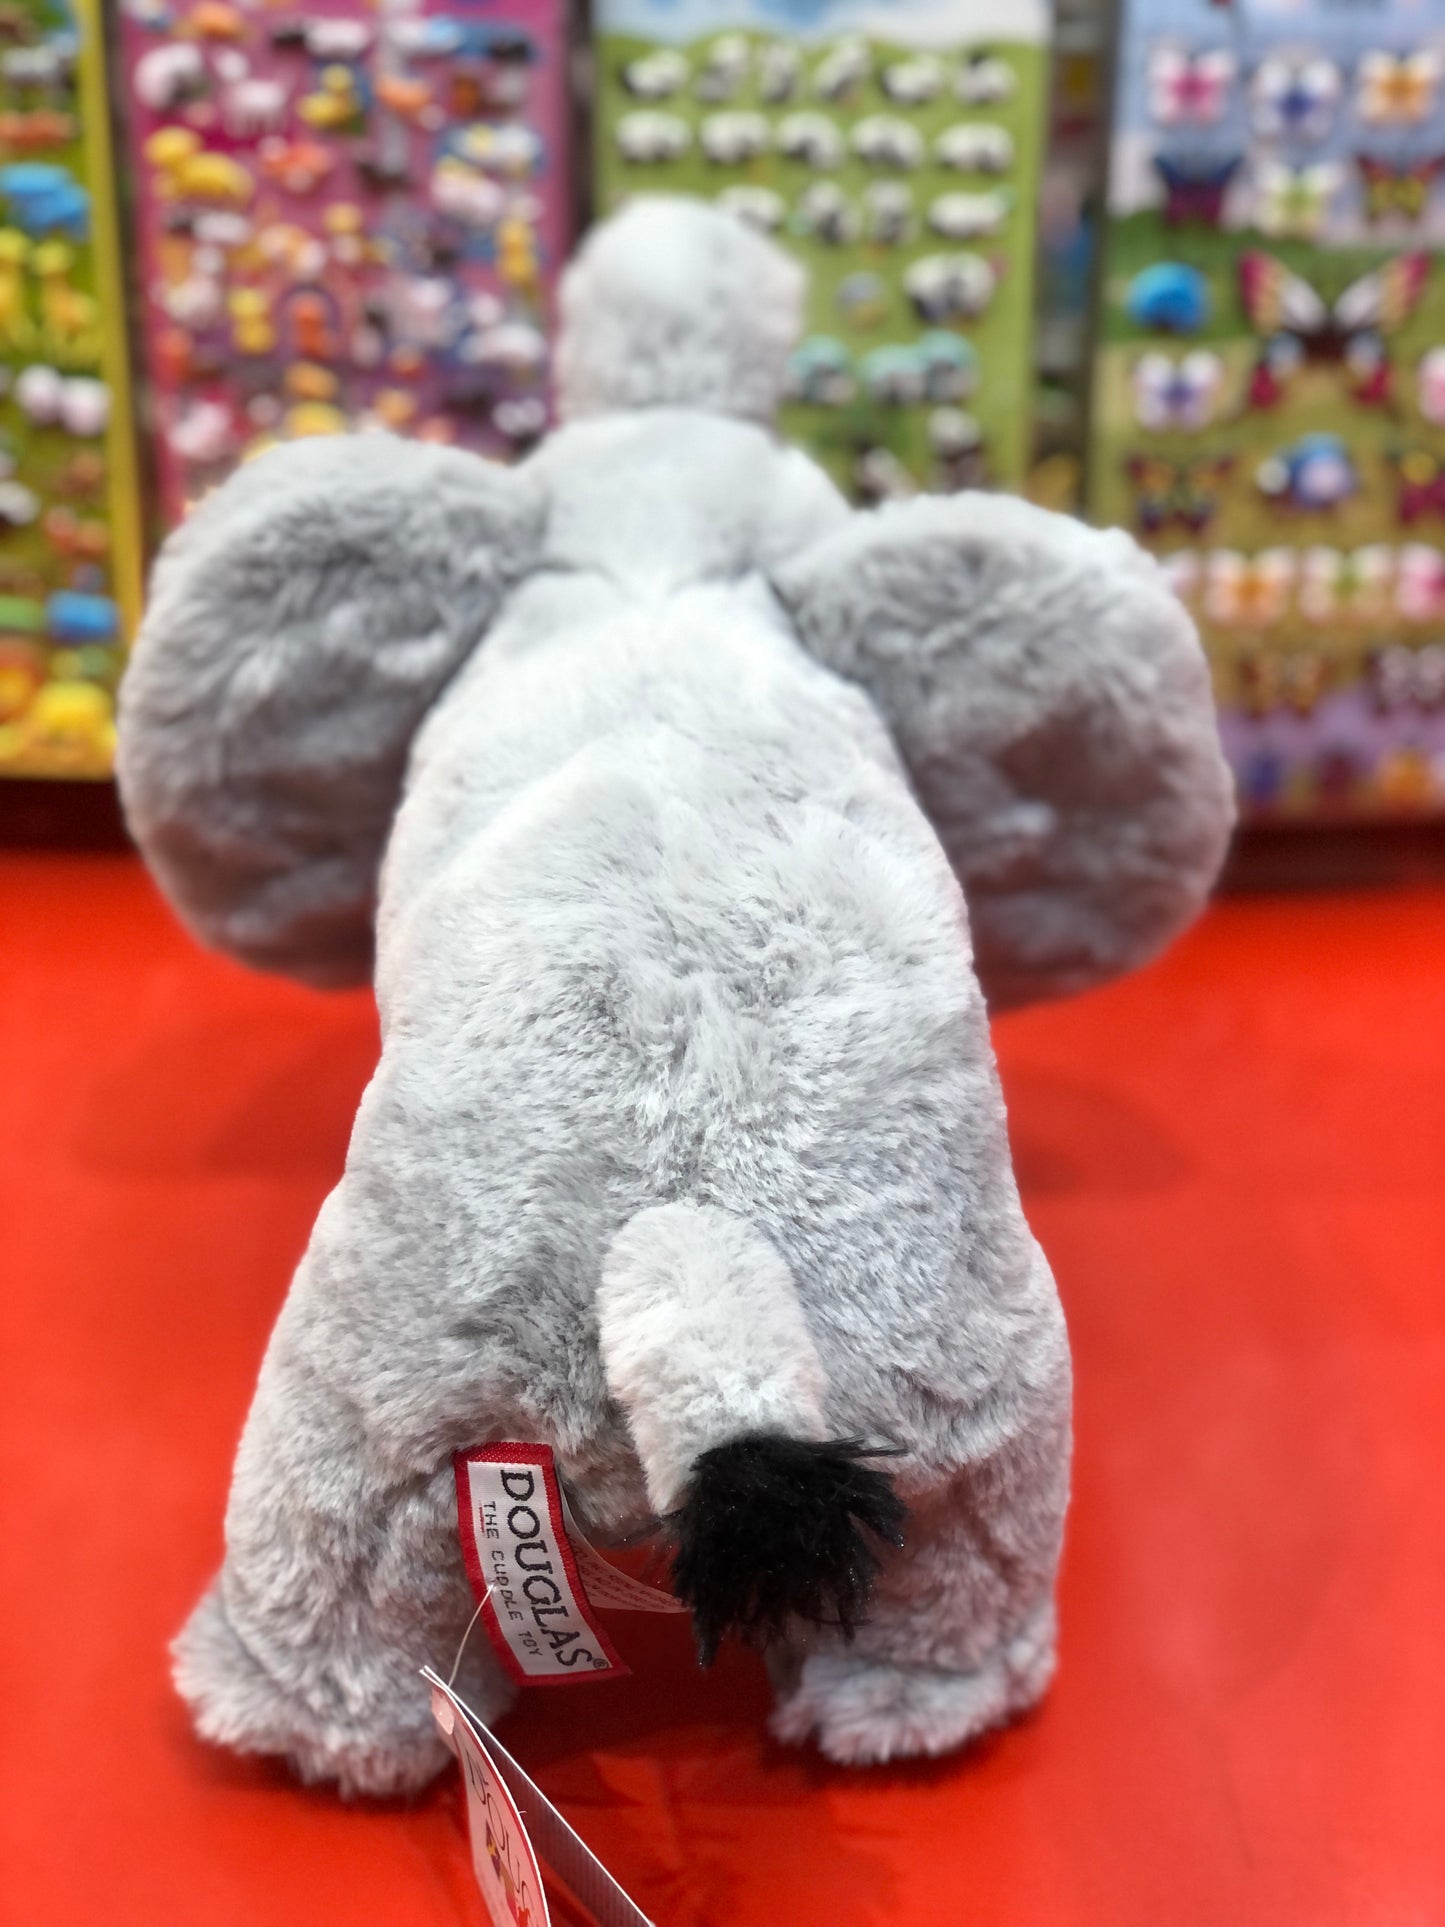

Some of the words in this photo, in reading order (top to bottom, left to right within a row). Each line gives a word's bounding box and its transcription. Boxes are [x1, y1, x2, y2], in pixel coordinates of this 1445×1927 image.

[484, 1500, 500, 1539] THE
[491, 1550, 524, 1621] CUDDLE
[518, 1631, 543, 1656] TOY
